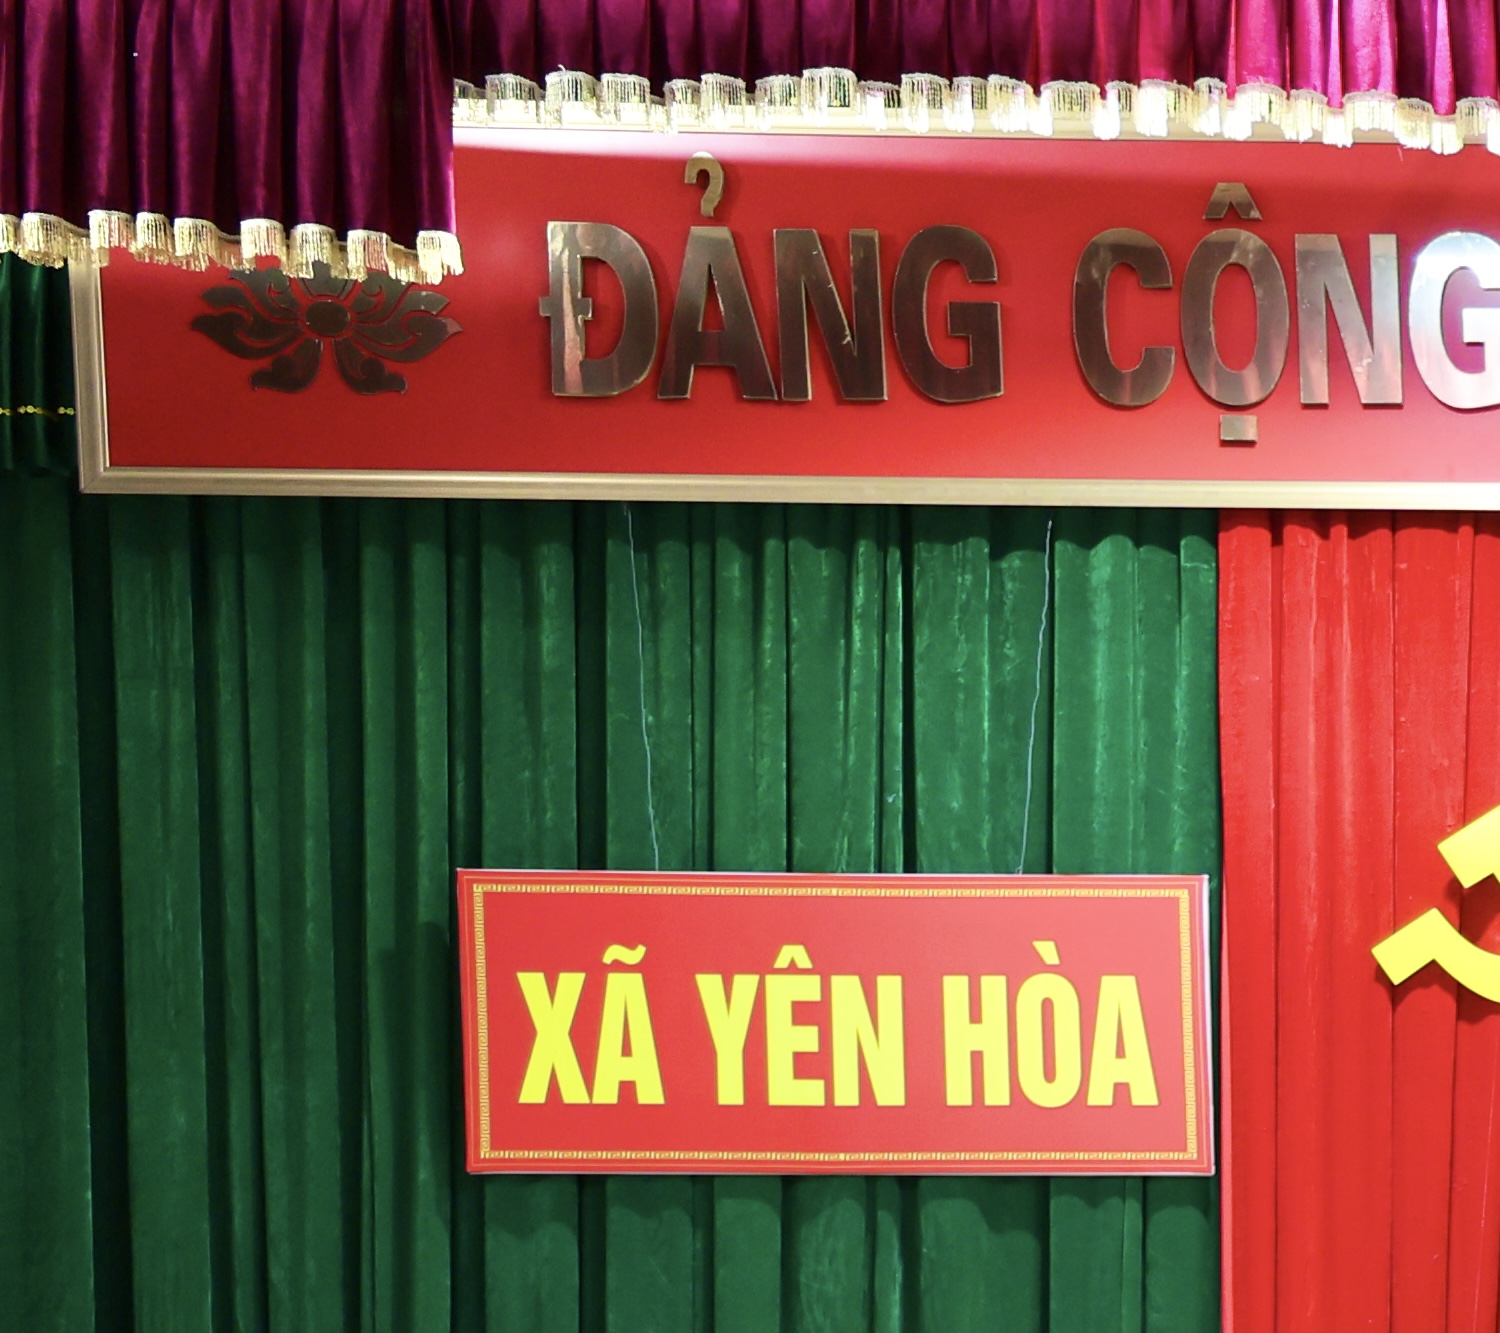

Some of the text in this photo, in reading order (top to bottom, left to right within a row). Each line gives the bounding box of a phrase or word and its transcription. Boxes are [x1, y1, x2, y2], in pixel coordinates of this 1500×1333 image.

[539, 149, 1003, 410] ĐẢNG
[516, 940, 1160, 1109] XÃ YÊN HÒA
